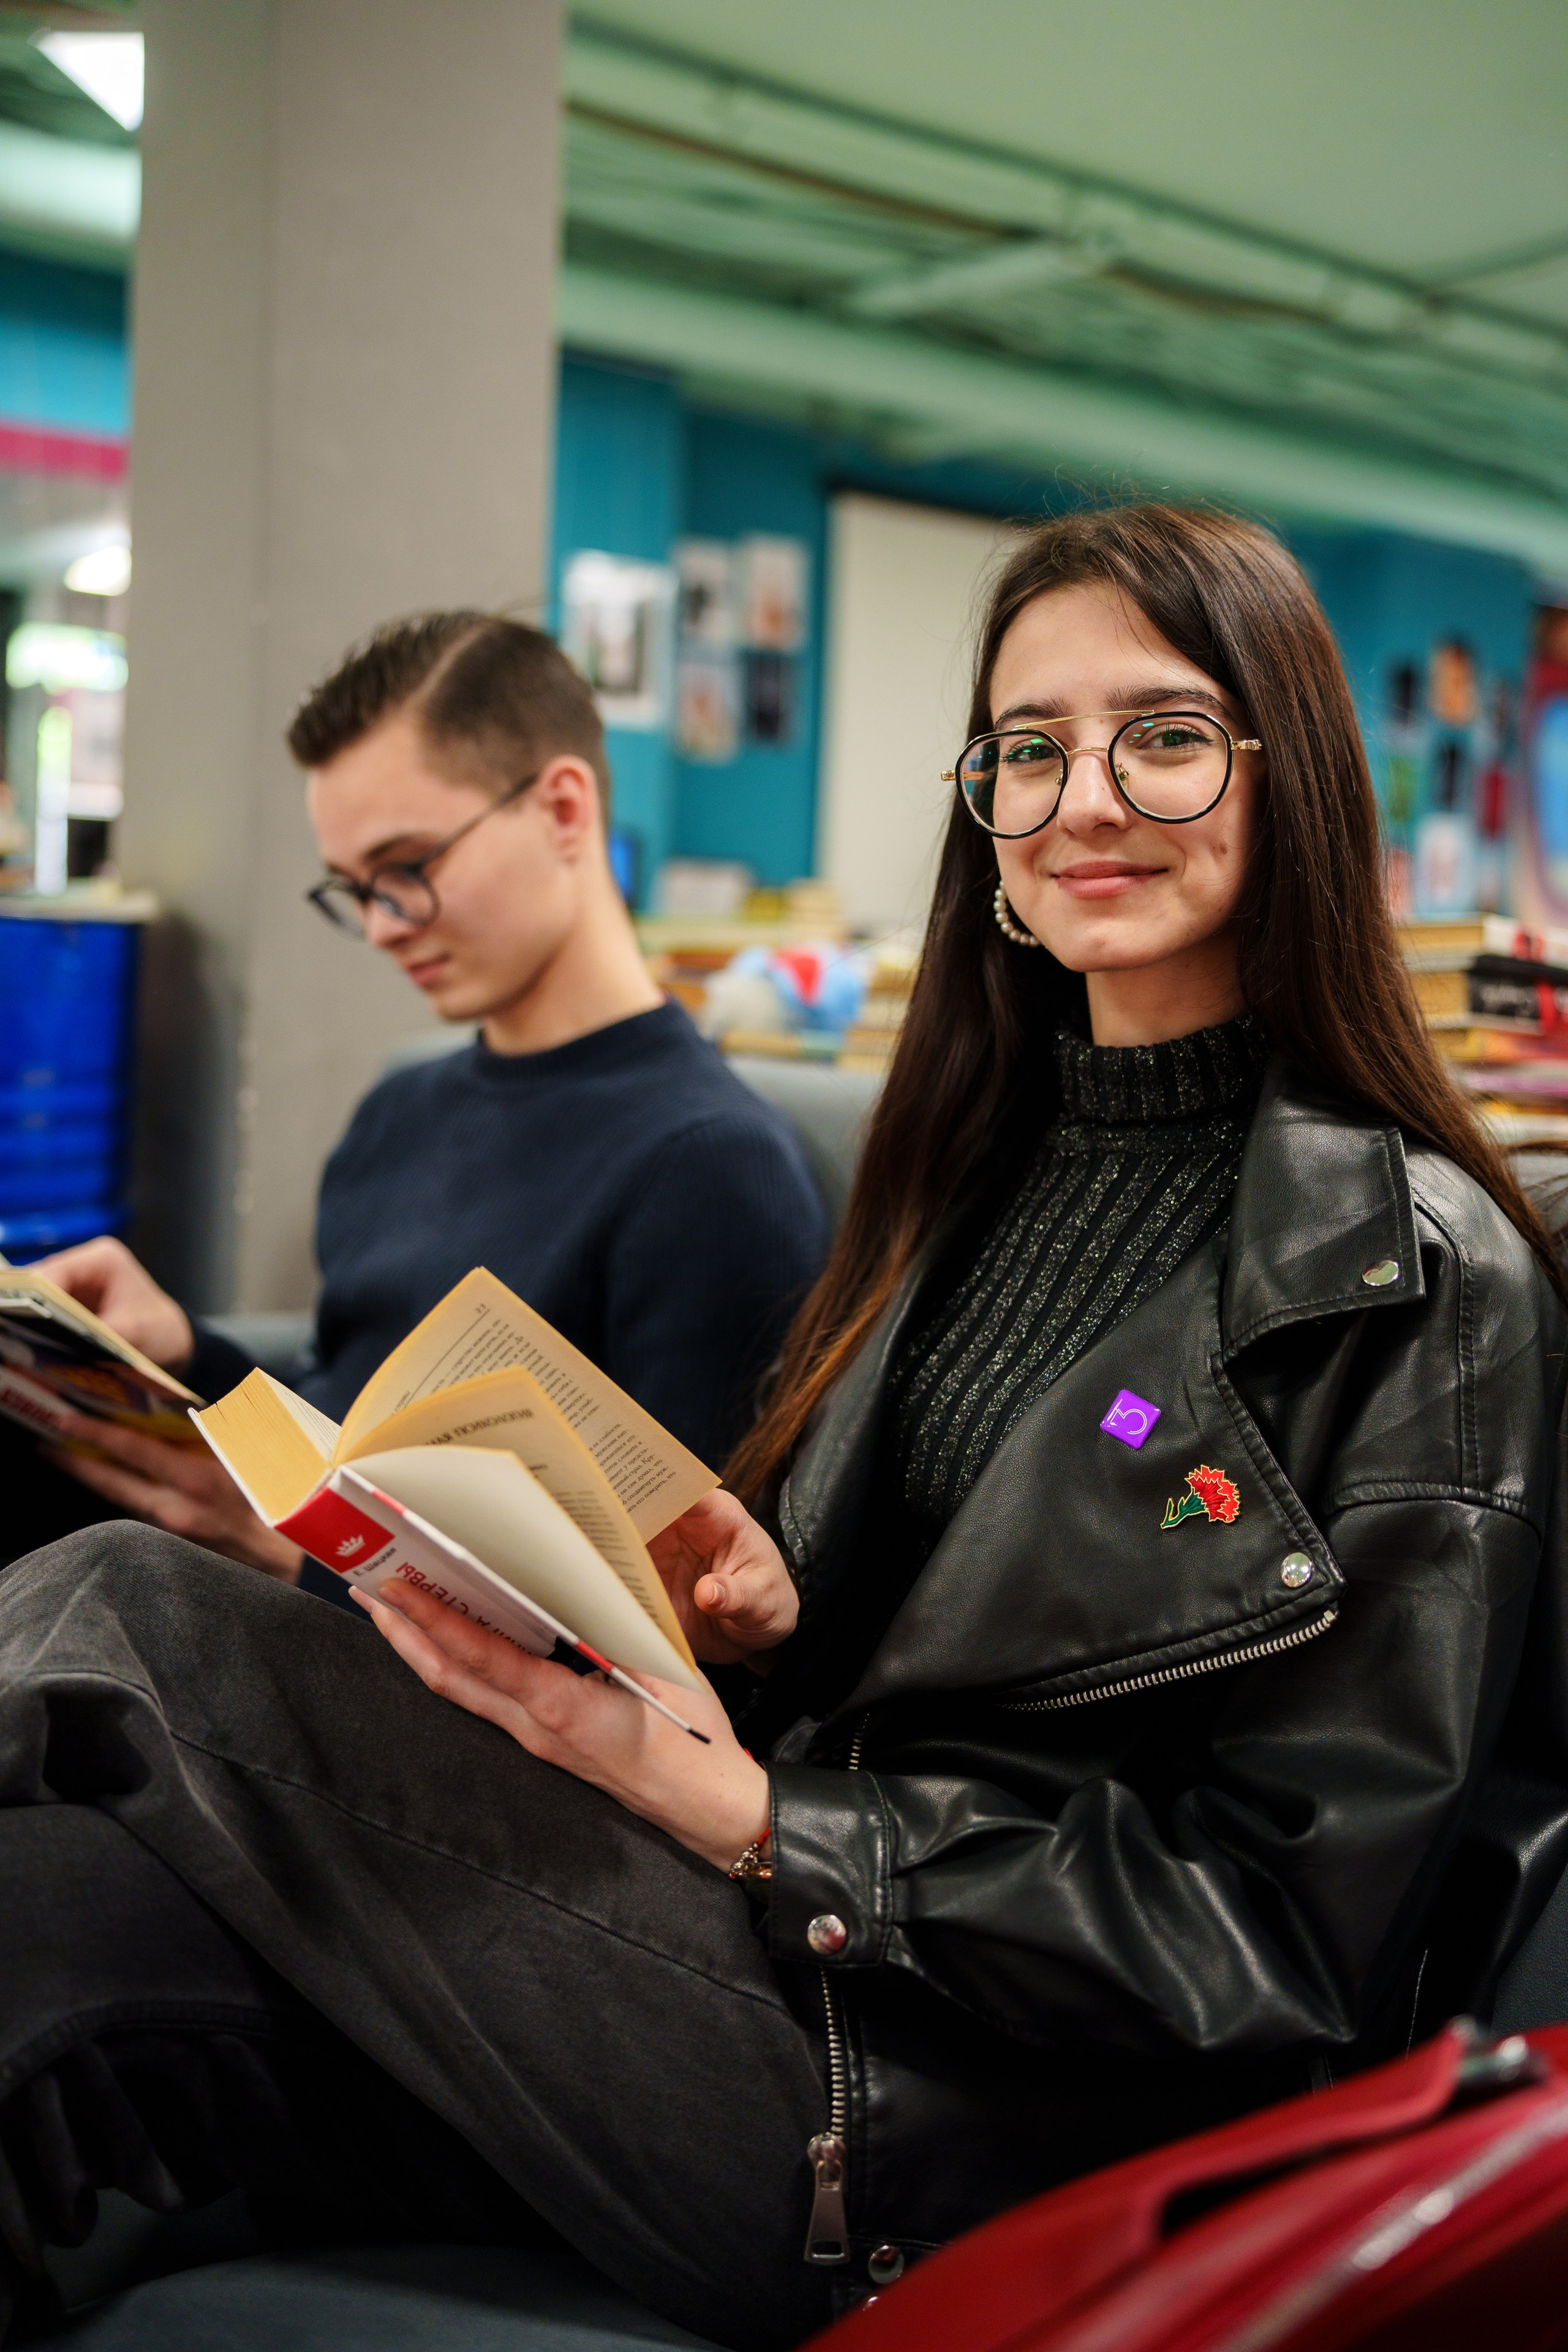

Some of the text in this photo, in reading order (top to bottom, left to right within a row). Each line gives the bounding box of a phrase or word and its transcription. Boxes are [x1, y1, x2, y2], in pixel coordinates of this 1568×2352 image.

[599, 1423, 622, 1442] слабости.
[595, 1439, 617, 1458] мужским
[628, 1448, 648, 1465] предста-
[605, 1462, 617, 1474] готов
[618, 1446, 638, 1461] сложить
[628, 1465, 642, 1476] страх.
[641, 1454, 655, 1464] Кру-
[627, 1477, 656, 1501] сподвигнуть
[656, 1466, 668, 1477] муж-
[638, 1469, 654, 1481] думал,
[644, 1480, 668, 1498] поверить,
